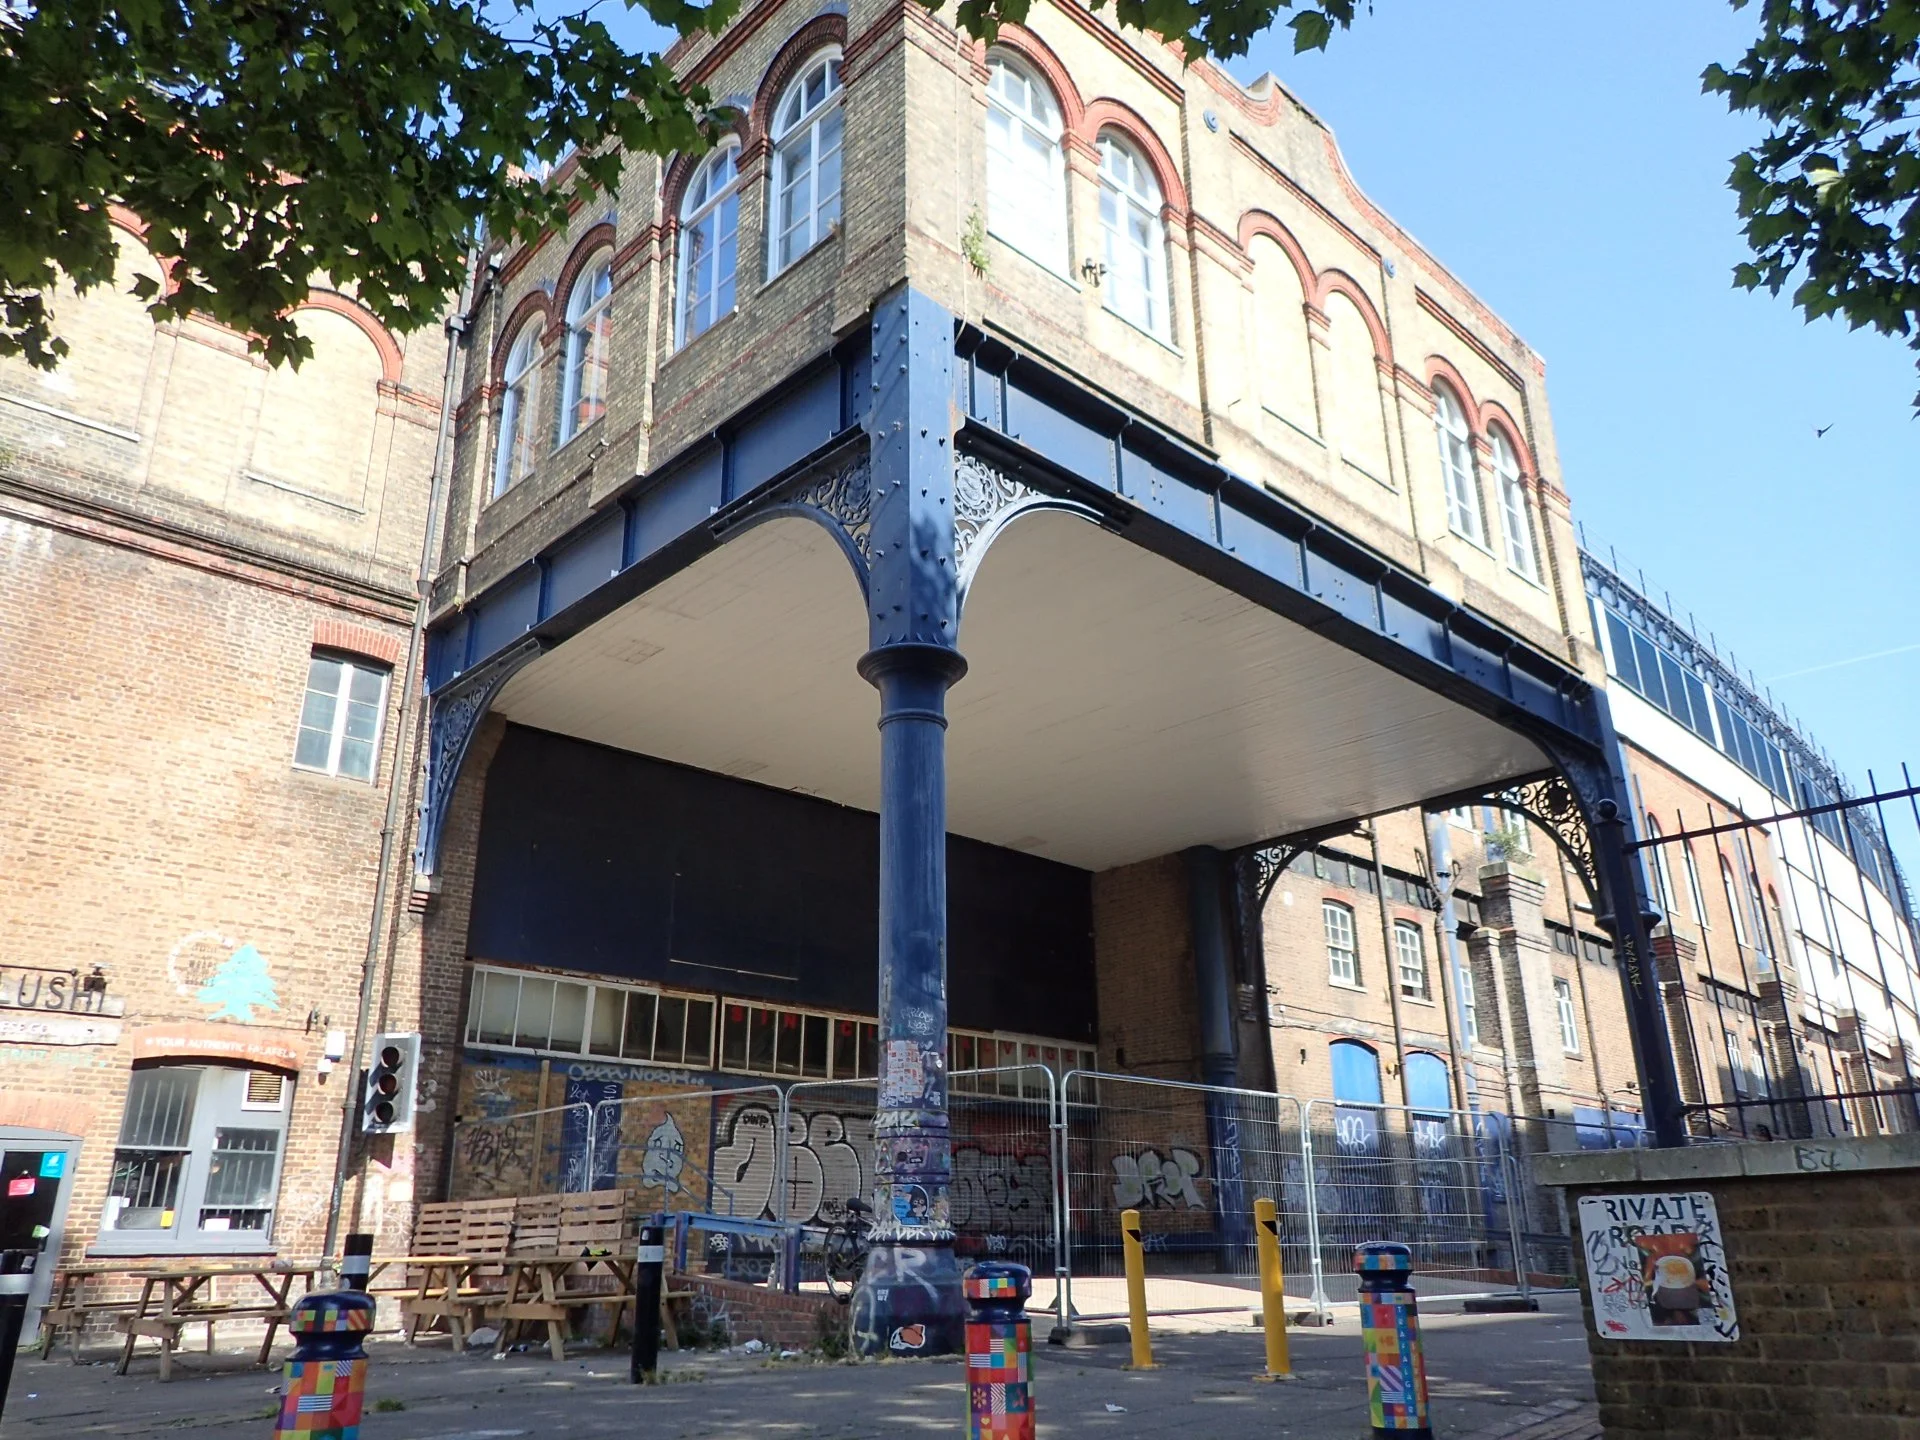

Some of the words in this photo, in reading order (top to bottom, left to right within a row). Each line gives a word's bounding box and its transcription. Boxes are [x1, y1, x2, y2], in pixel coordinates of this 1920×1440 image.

[961, 1036, 1074, 1062] ALVAGE
[1588, 1196, 1707, 1222] RIVATE
[1397, 1306, 1415, 1414] TRAFALGAR
